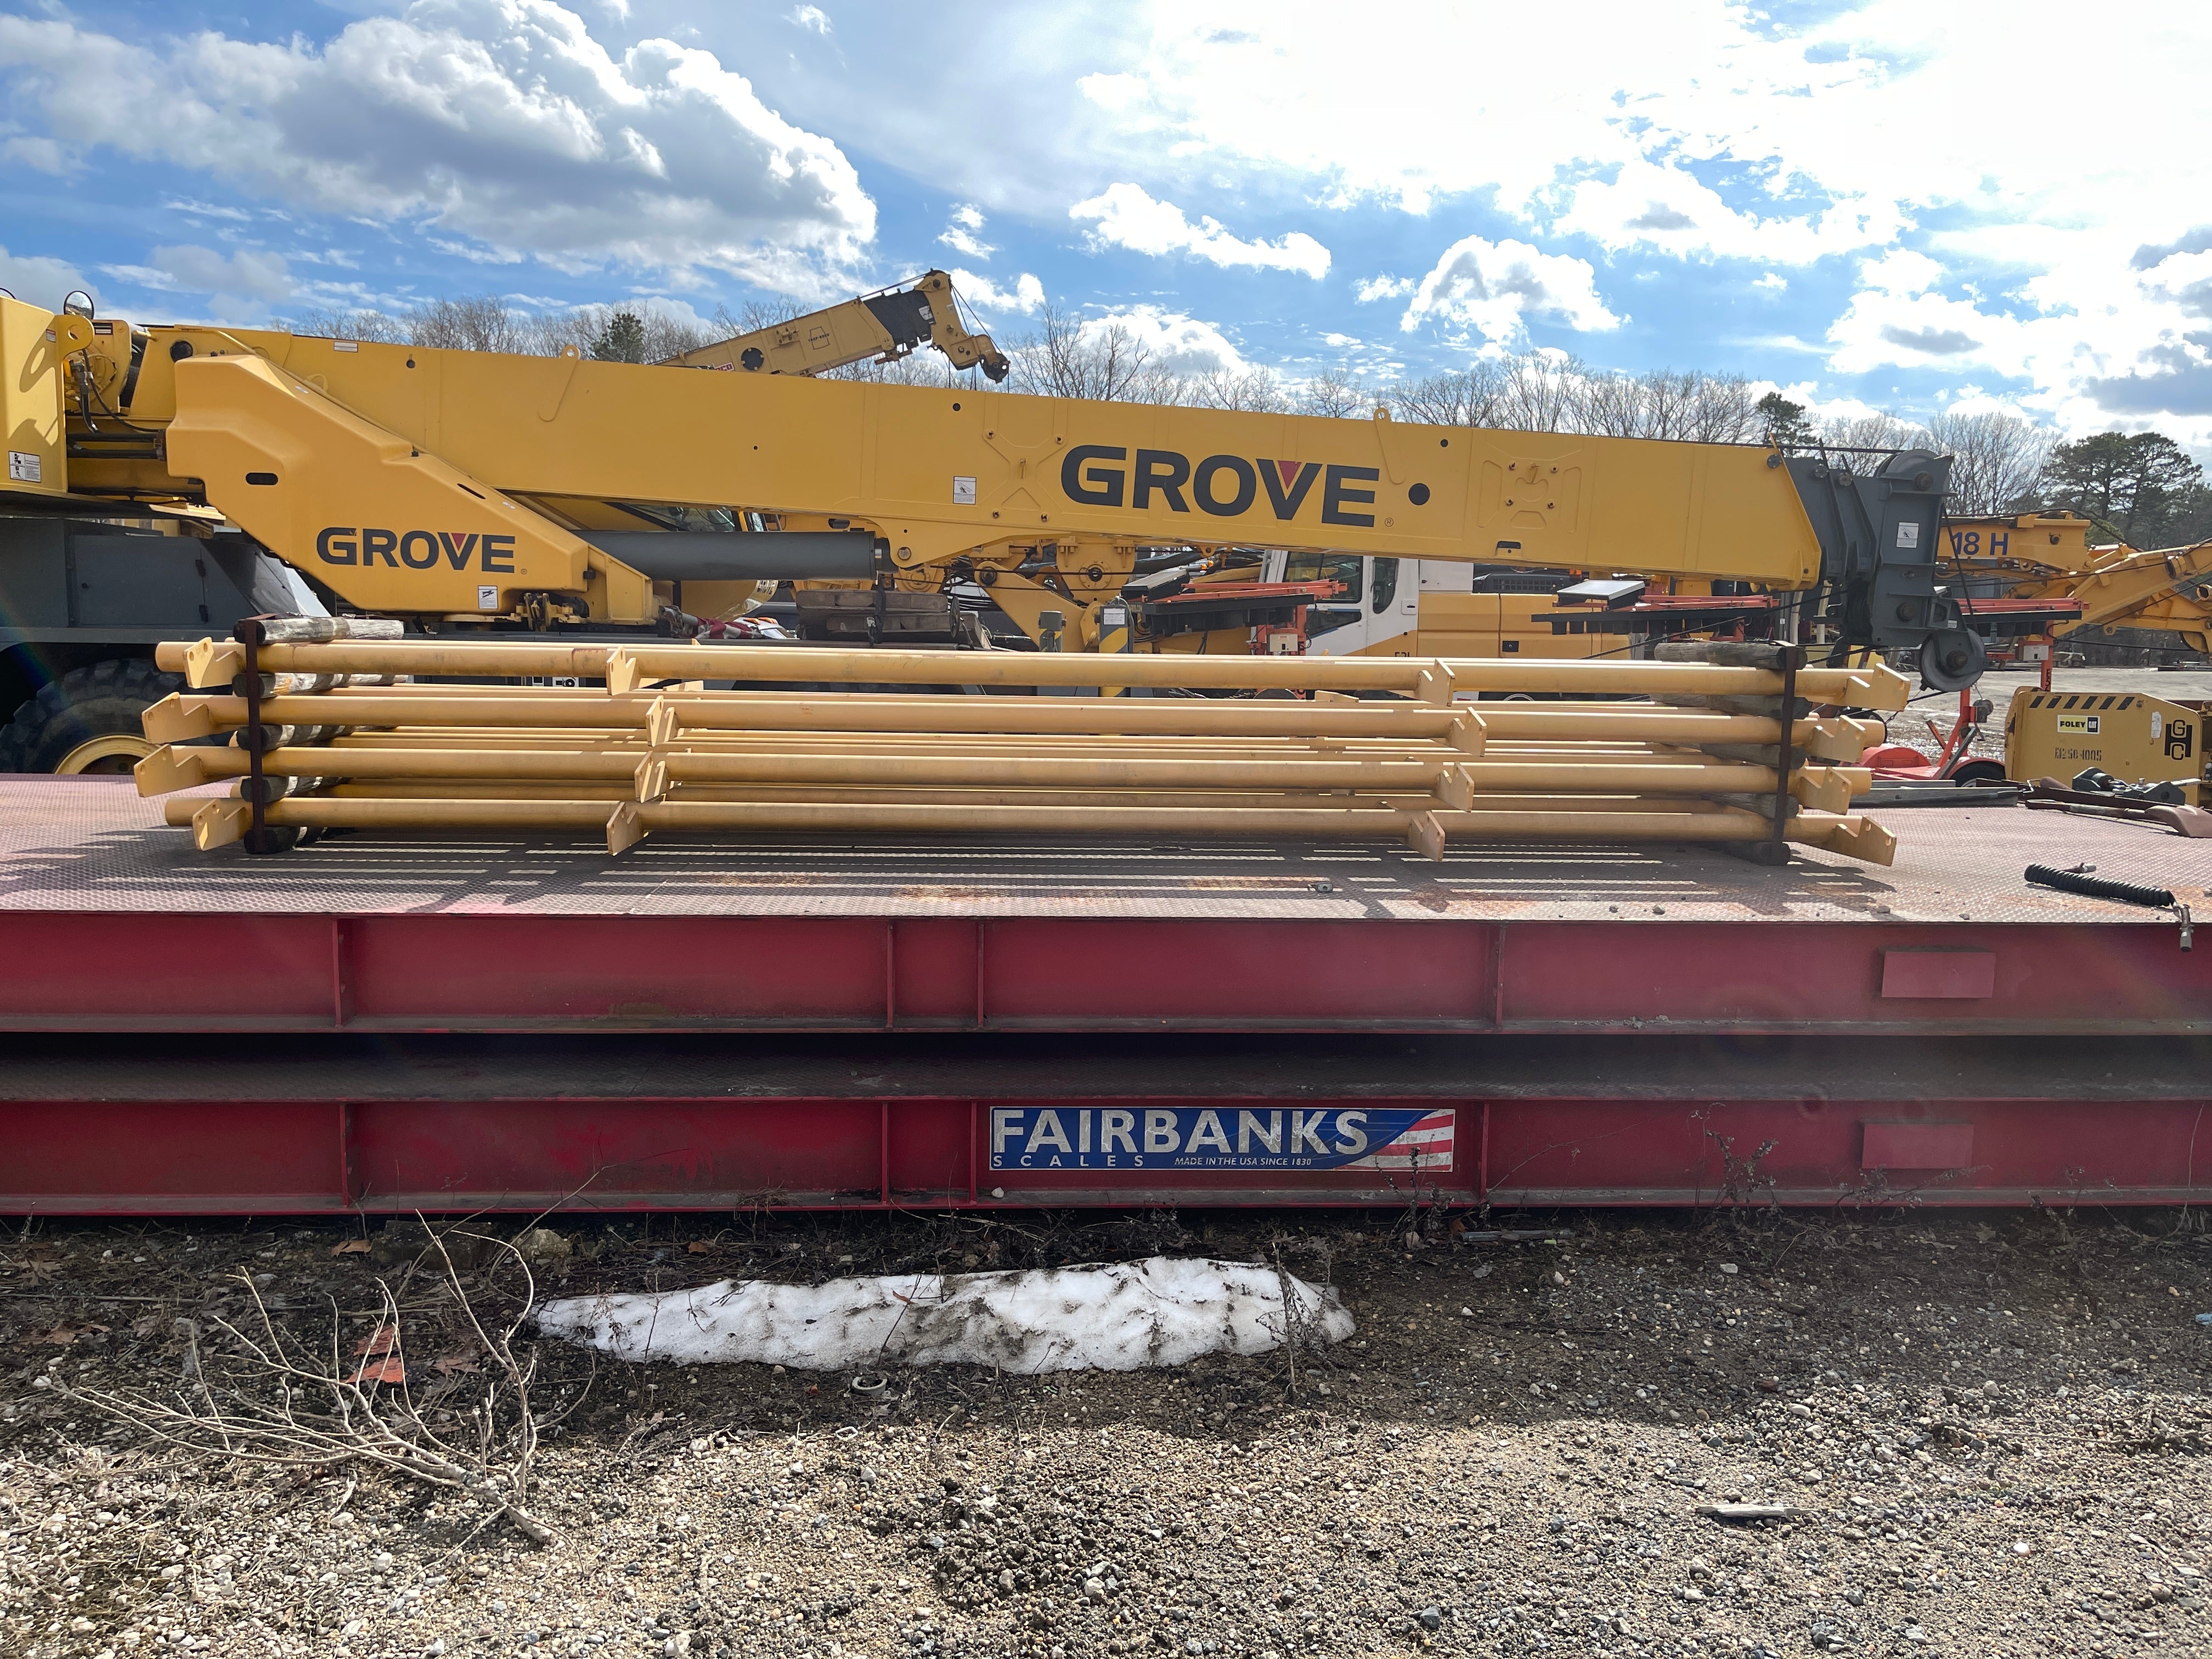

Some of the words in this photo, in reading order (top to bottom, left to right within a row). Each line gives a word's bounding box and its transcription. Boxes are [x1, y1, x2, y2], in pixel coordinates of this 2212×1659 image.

[1061, 444, 1380, 528] GROVE
[317, 527, 515, 573] GROVE
[1953, 532, 1980, 555] 18
[1990, 533, 2008, 555] H
[994, 1109, 1368, 1154] FAIRBANKS
[993, 1155, 1143, 1166] SCALES
